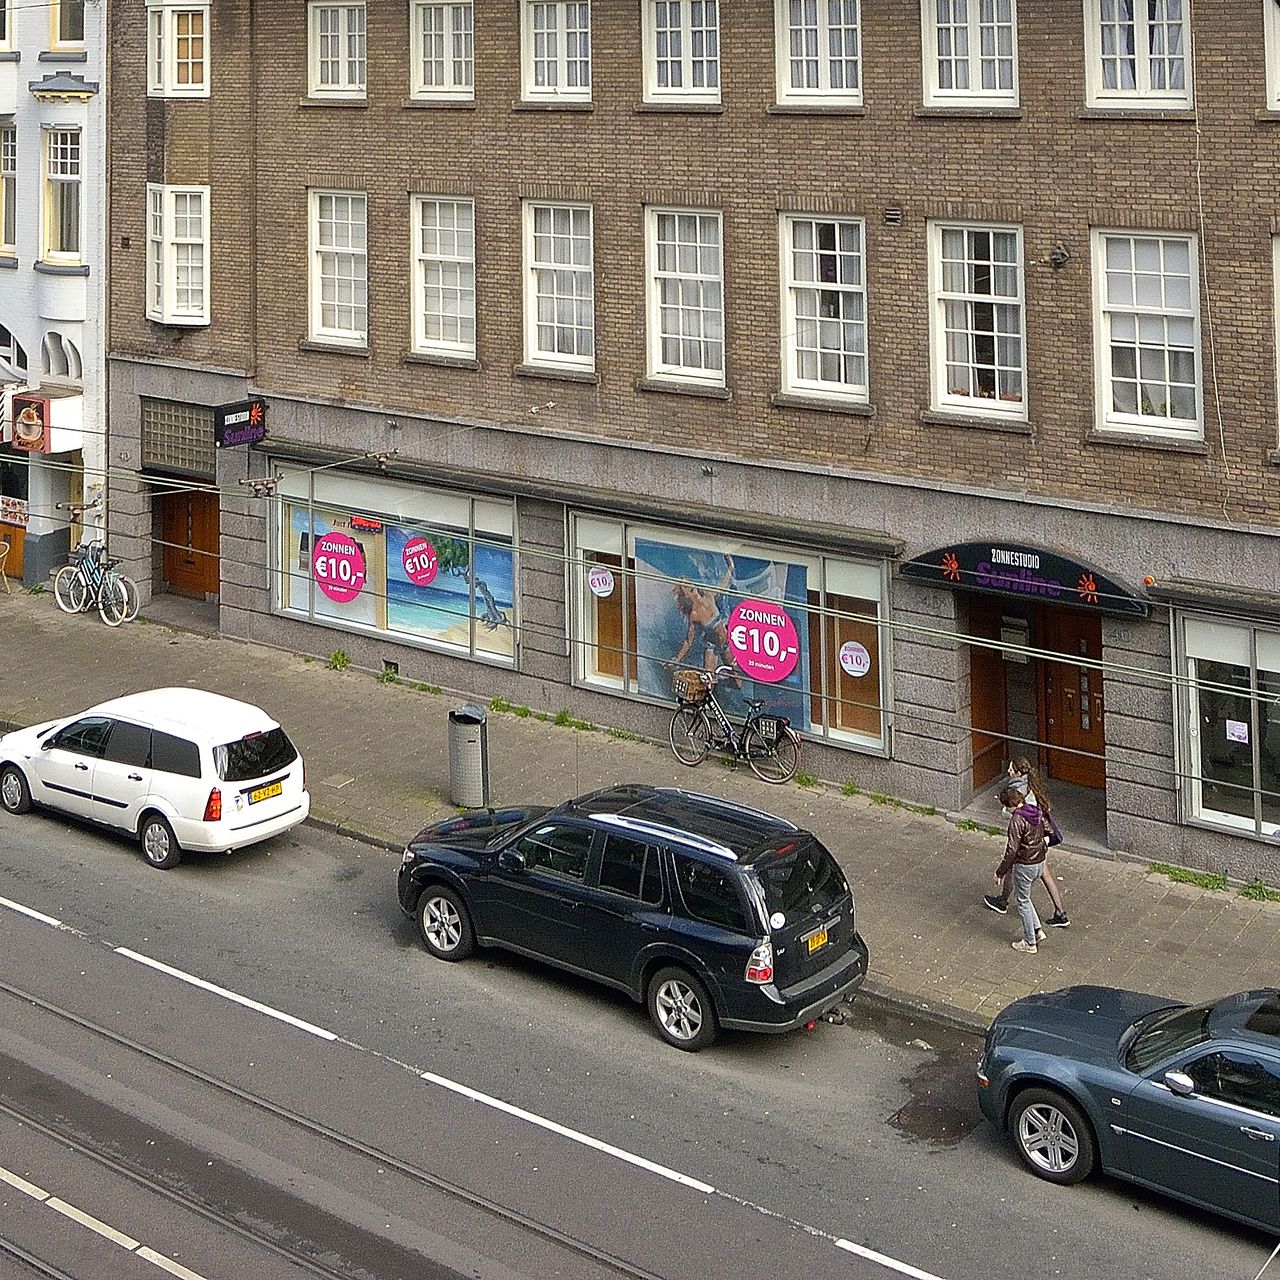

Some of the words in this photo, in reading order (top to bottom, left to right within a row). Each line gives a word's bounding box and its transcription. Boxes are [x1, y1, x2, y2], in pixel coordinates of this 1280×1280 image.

[321, 541, 356, 556] ZONNEN
[405, 542, 428, 556] ZONNEN
[991, 548, 1040, 570] ZONNESTUDIO
[315, 555, 364, 586] €10,-
[739, 607, 787, 628] ZONNEN
[730, 625, 797, 663] €10,-
